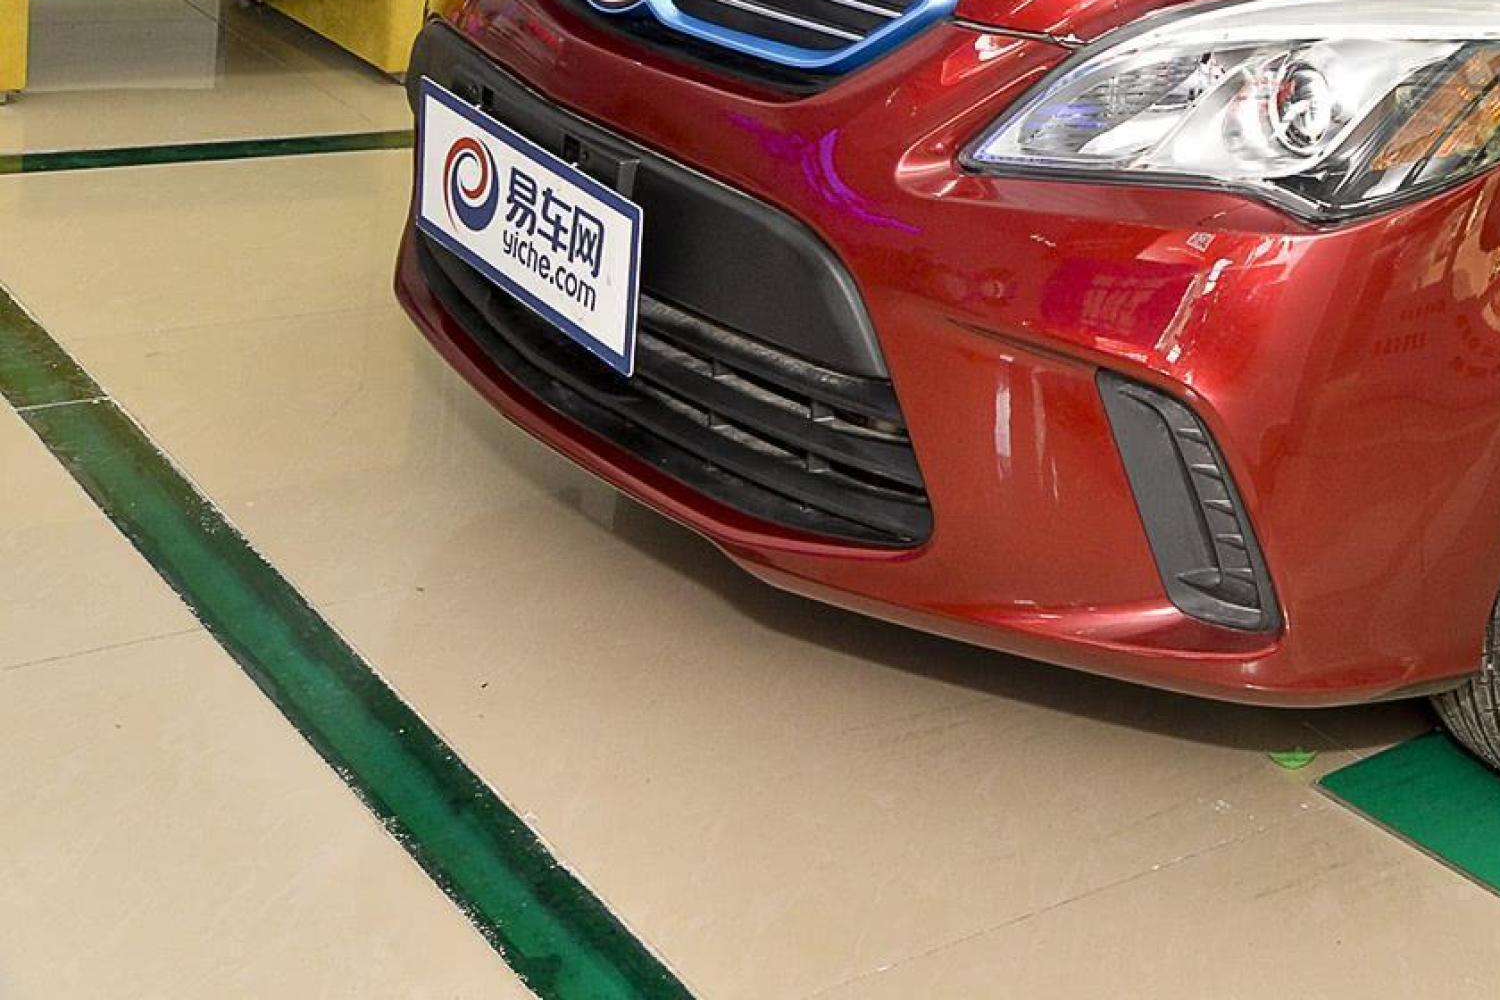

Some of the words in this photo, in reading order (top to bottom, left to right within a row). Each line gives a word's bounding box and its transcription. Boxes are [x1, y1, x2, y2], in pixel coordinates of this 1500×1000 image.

[505, 167, 604, 278] 易车网
[503, 231, 597, 311] yiche.com
